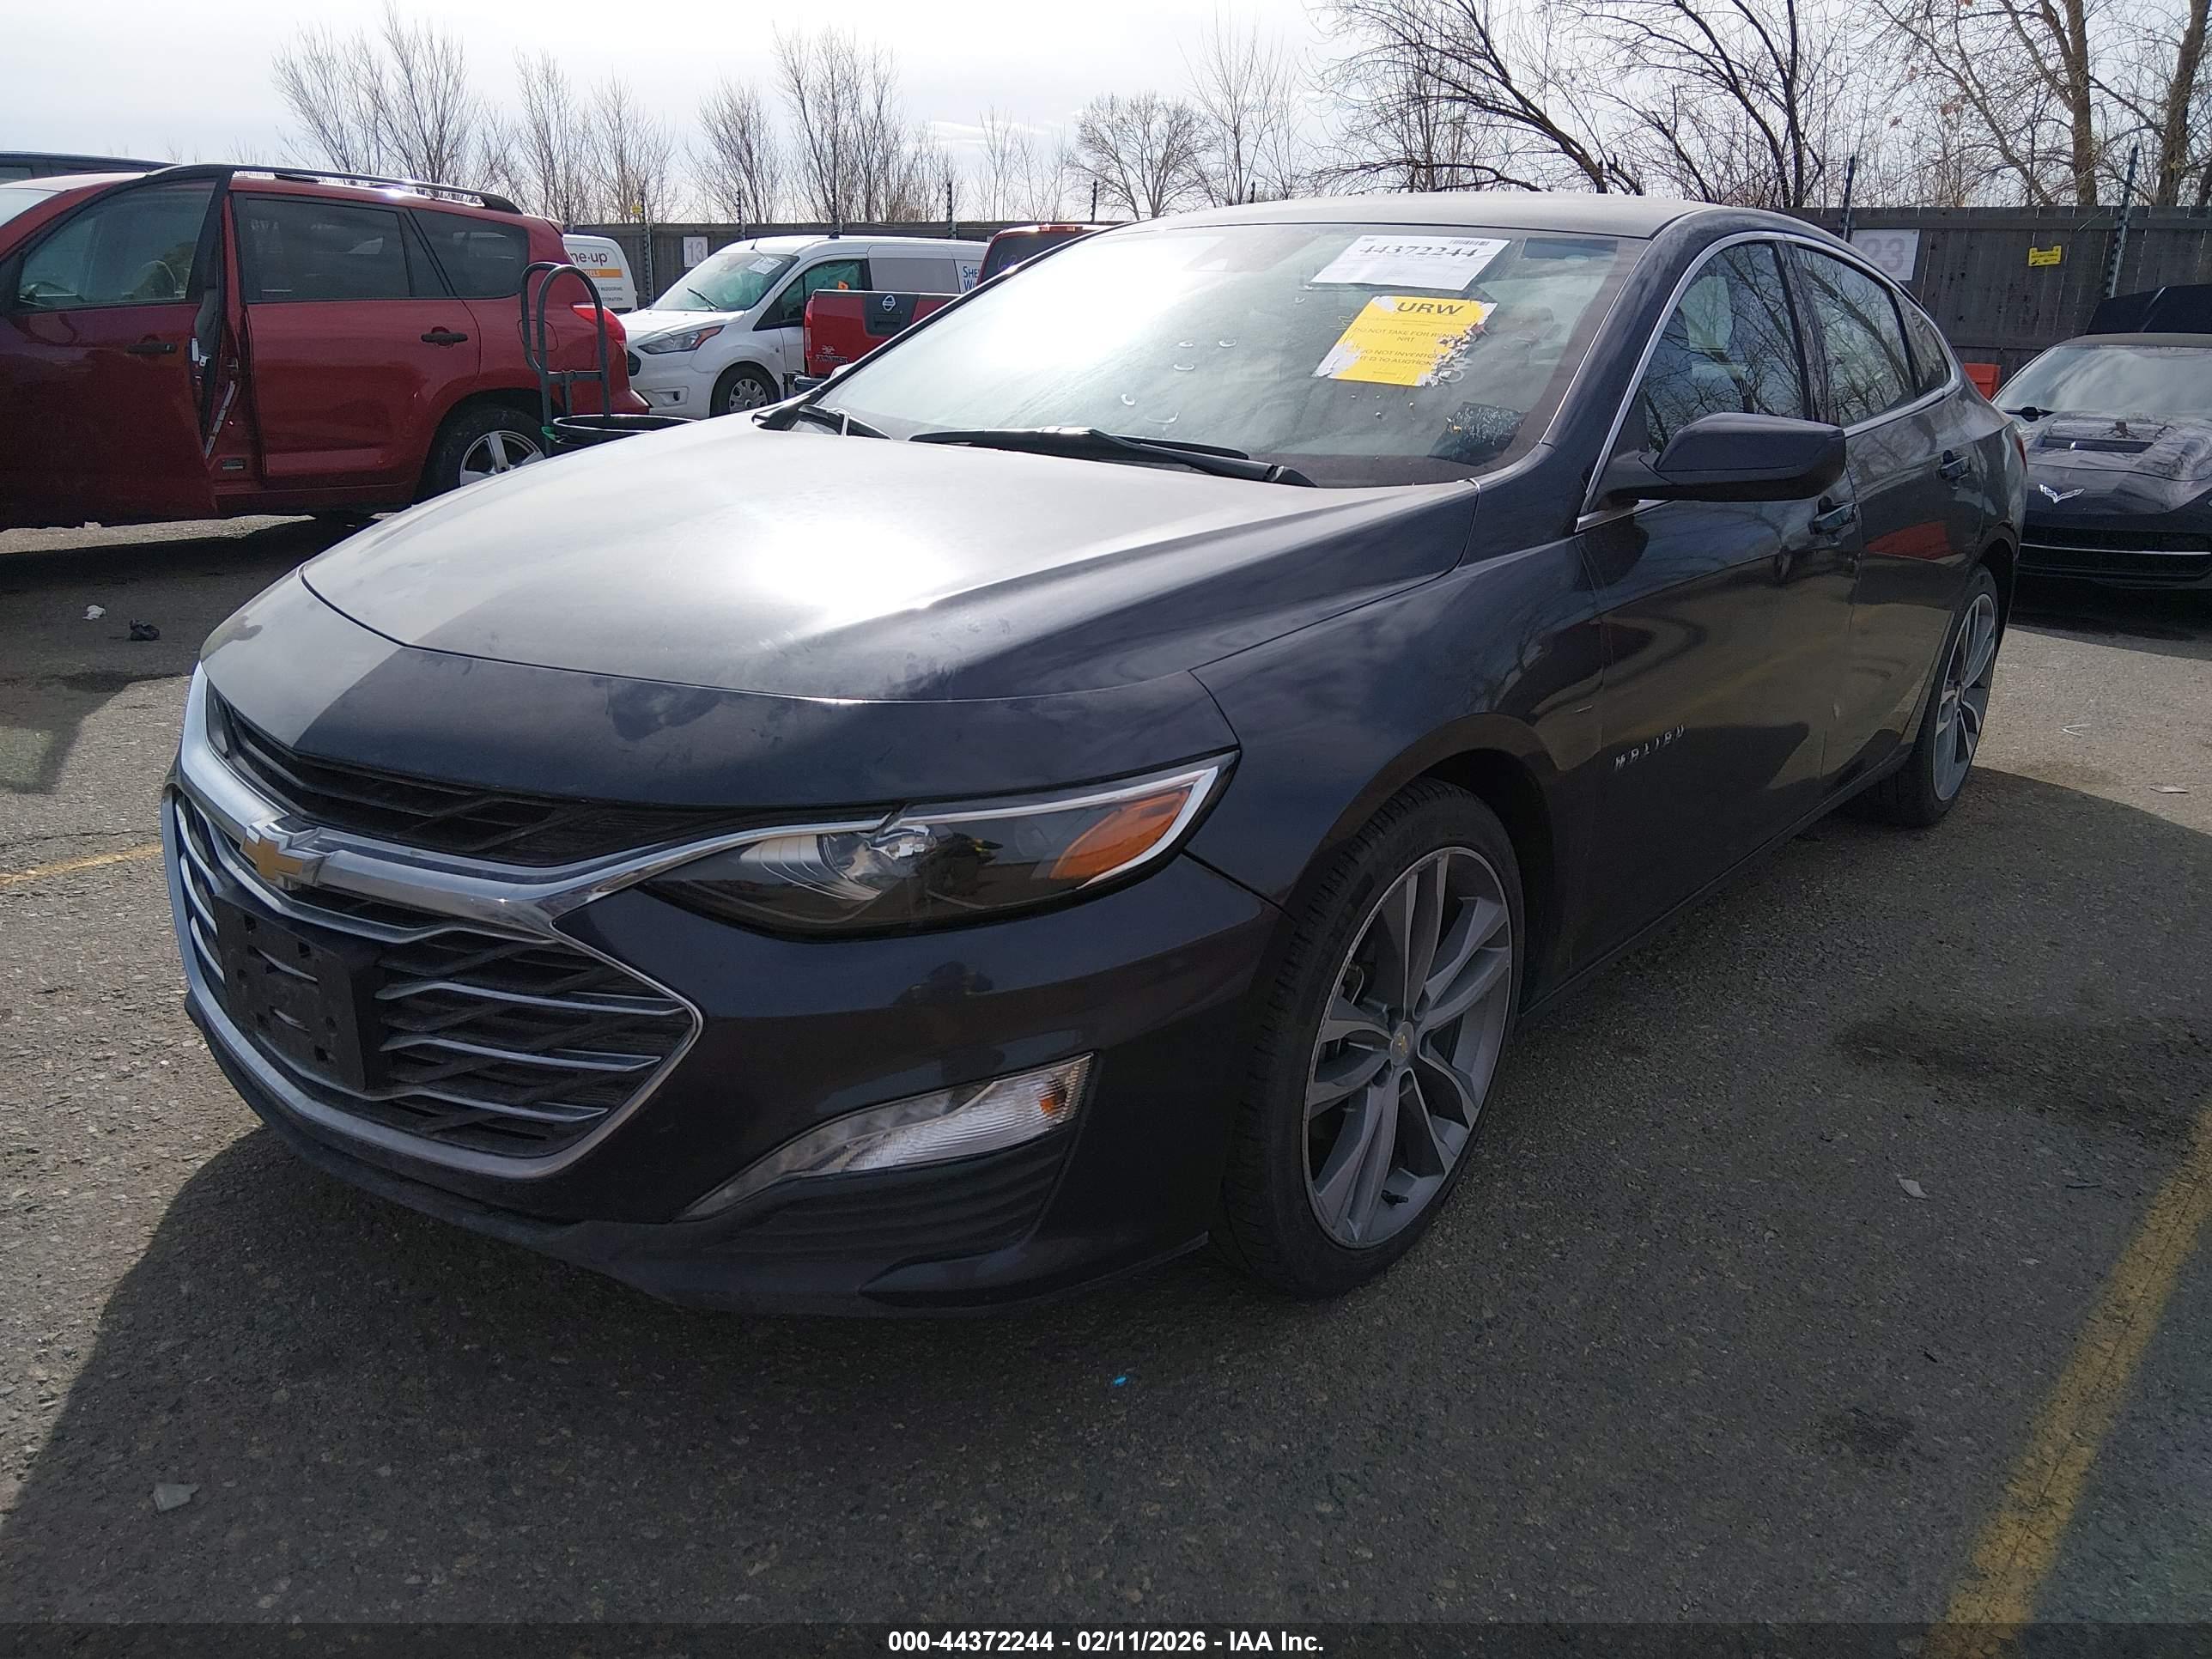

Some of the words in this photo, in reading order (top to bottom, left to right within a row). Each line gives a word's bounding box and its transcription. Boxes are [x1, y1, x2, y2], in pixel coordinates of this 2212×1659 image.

[689, 242, 704, 262] 13
[1360, 245, 1478, 258] 44372244
[1861, 238, 1905, 273] 23
[963, 266, 979, 278] SHE
[1397, 302, 1464, 315] URW
